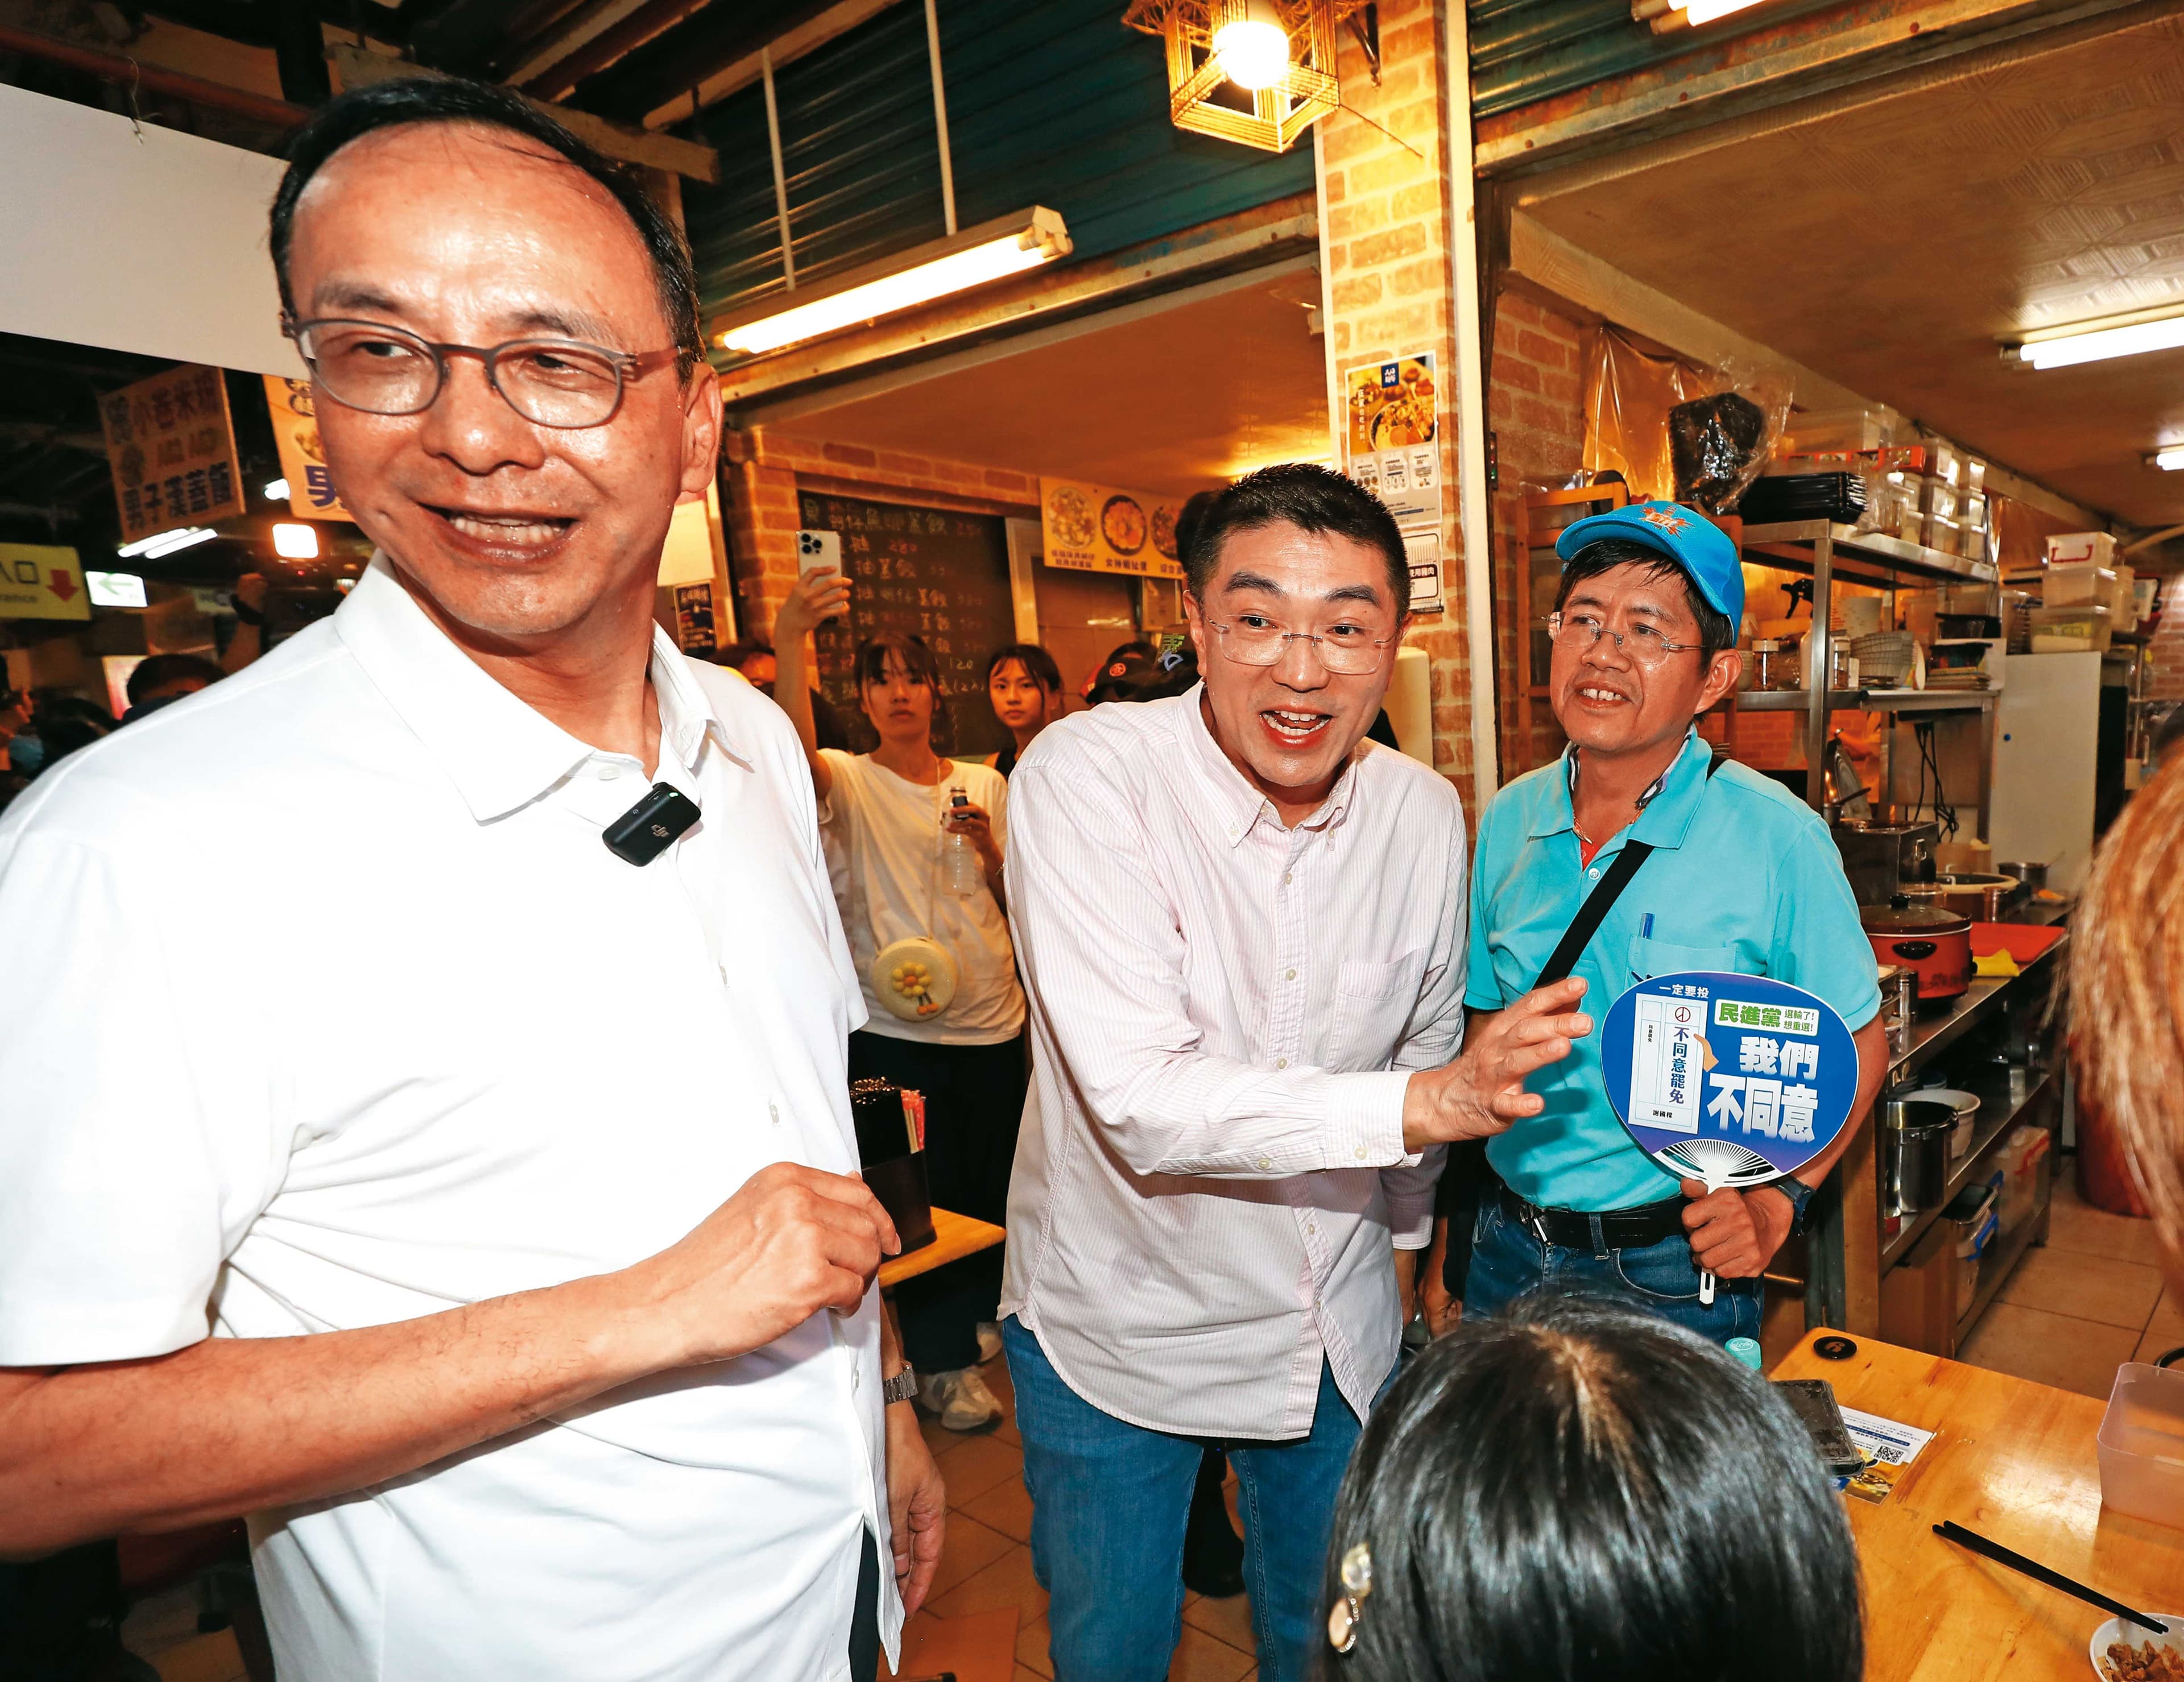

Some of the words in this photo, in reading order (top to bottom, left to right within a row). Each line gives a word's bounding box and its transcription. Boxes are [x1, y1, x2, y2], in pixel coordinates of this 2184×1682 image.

[1659, 984, 1709, 999] 一定要投
[1719, 1002, 1782, 1028] 民進黨
[1669, 1026, 1690, 1104] 不同意罷免
[1739, 1036, 1820, 1080] 我們
[1707, 1072, 1818, 1144] 不同意
